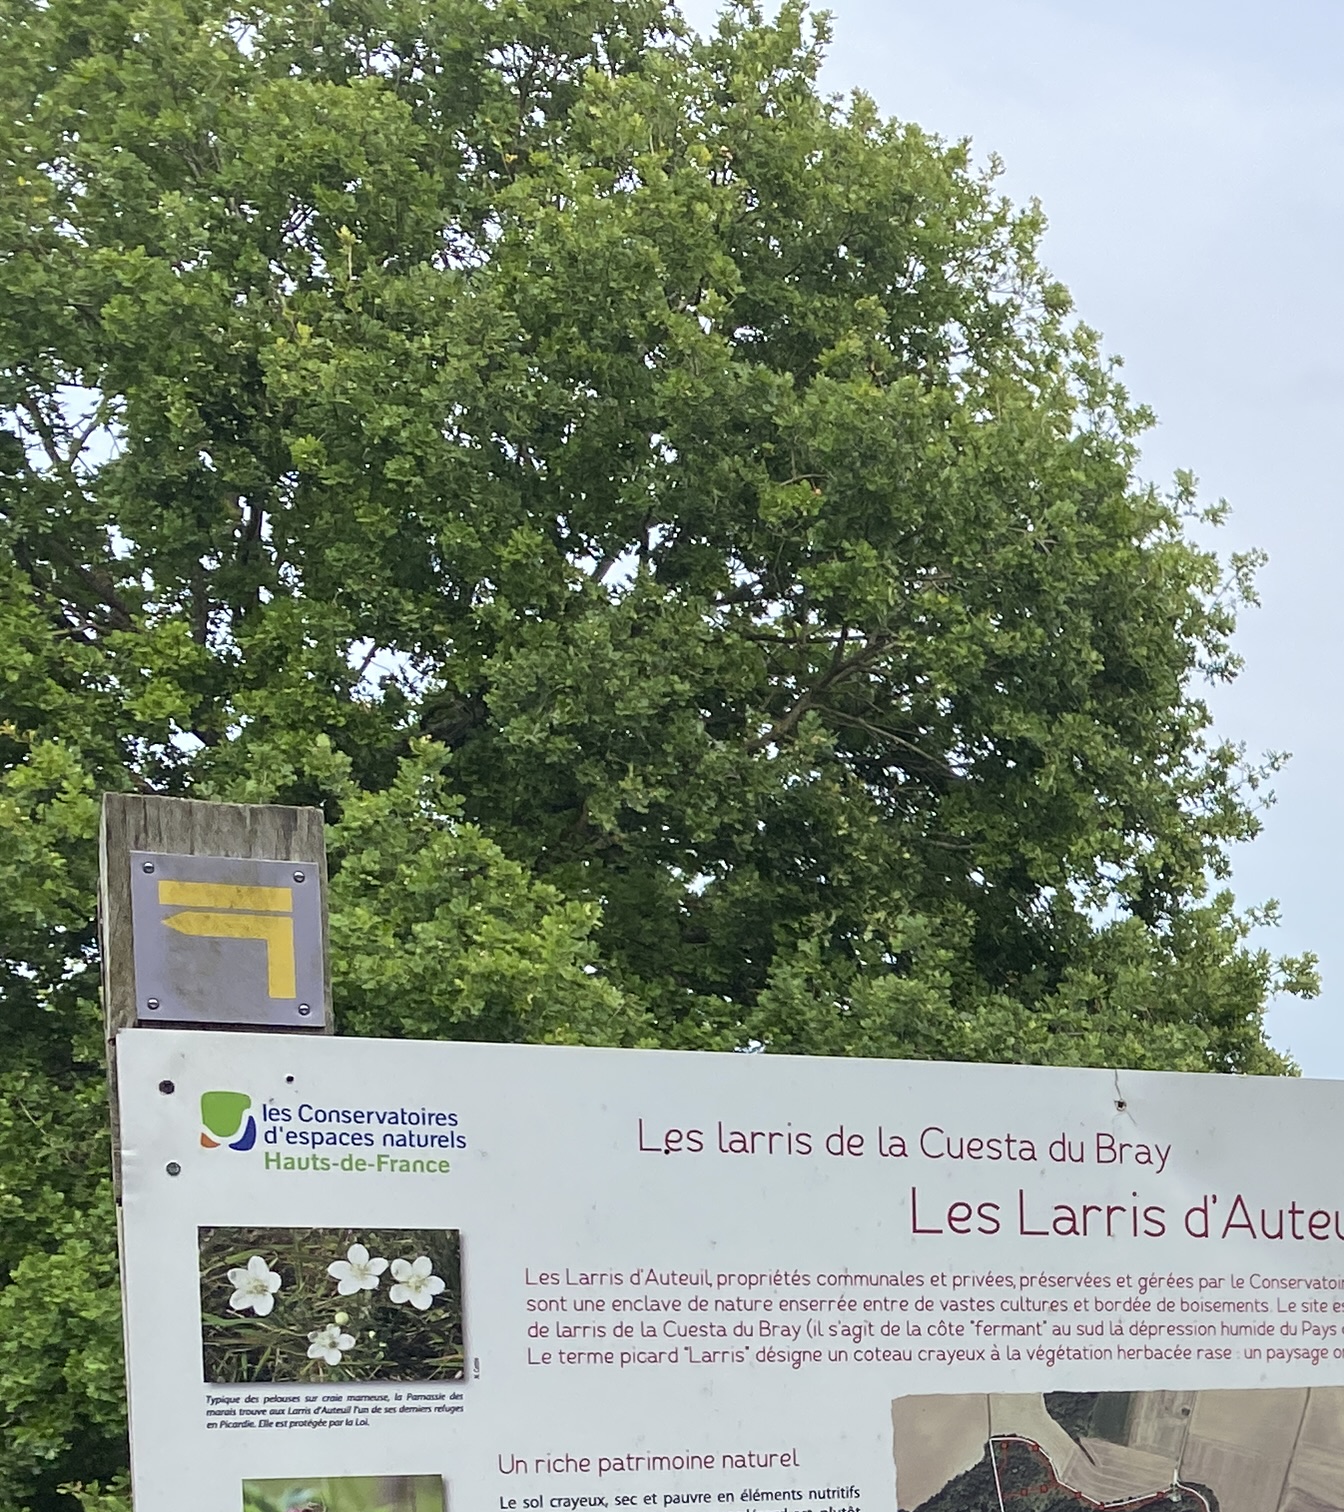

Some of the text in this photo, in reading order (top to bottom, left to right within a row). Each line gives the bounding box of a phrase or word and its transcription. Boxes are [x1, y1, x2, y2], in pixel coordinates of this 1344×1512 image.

[262, 1103, 458, 1127] les Conservatoires
[264, 1126, 467, 1149] d'espaces naturels
[638, 1117, 1172, 1175] Les larris de la Cuesta du Bray
[264, 1151, 450, 1174] Hauts-de-France
[911, 1186, 1001, 1235] Les
[1019, 1188, 1166, 1238] Larris
[525, 1267, 560, 1286] Les
[565, 1266, 624, 1286] Larris
[716, 1268, 811, 1289] propriétés
[816, 1269, 925, 1287] communales
[929, 1271, 948, 1288] et
[1019, 1270, 1112, 1292] préservées
[1116, 1273, 1133, 1289] et
[1137, 1271, 1194, 1296] gérées
[1198, 1277, 1226, 1293] par
[1230, 1273, 1245, 1289] le
[526, 1295, 568, 1312] sont
[573, 1298, 606, 1312] une
[611, 1294, 682, 1313] enclave
[687, 1294, 709, 1312] de
[714, 1296, 773, 1312] nature
[778, 1293, 858, 1312] enserrée
[863, 1296, 909, 1312] entre
[914, 1294, 935, 1312] de
[939, 1296, 996, 1313] vastes
[1000, 1294, 1069, 1313] cultures
[1073, 1297, 1090, 1313] et
[1094, 1295, 1152, 1313] bordée
[1156, 1296, 1176, 1313] de
[1277, 1297, 1297, 1313] Le
[1301, 1298, 1328, 1313] site
[498, 1447, 800, 1478] Un riche patrimoine naturel
[499, 1495, 517, 1510] Le
[522, 1494, 544, 1510] sol
[614, 1495, 638, 1506] sec
[643, 1493, 658, 1506] et
[663, 1493, 712, 1509] pauvre
[717, 1492, 735, 1503] en
[739, 1487, 804, 1503] éléments
[808, 1484, 861, 1500] nutritifs
